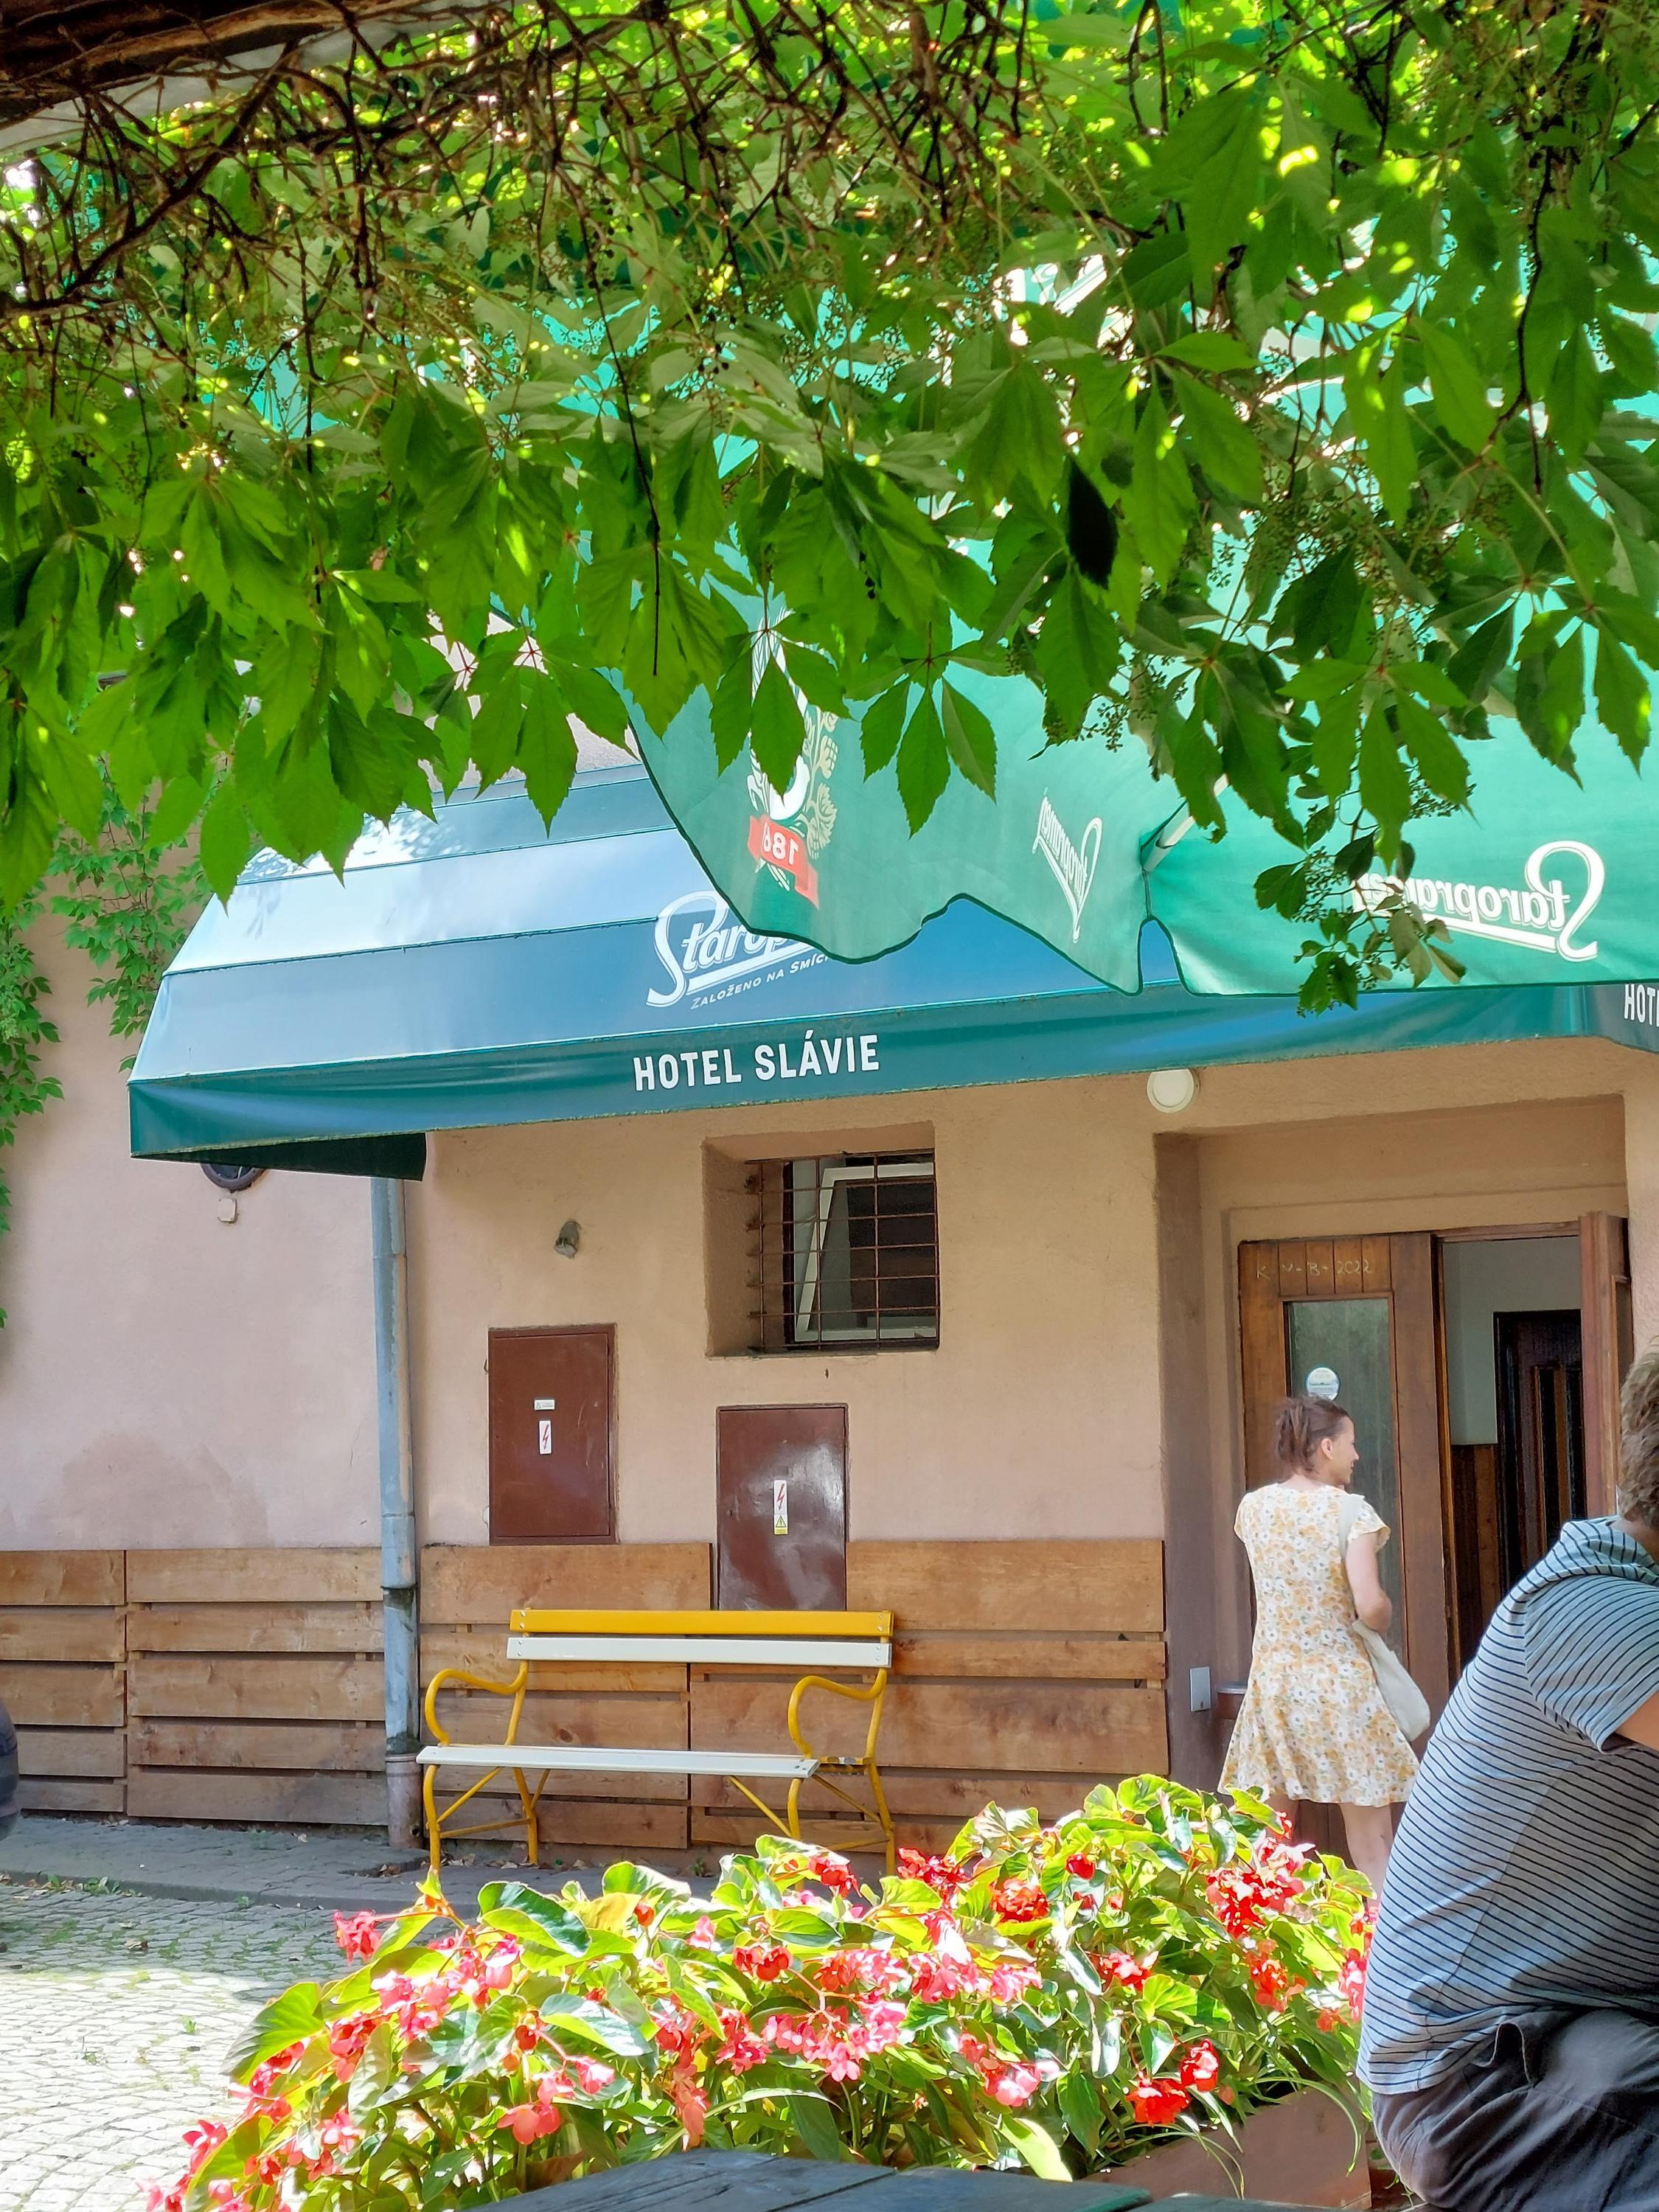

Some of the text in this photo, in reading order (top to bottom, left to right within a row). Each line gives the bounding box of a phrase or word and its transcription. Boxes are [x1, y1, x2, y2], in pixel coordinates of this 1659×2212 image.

[690, 953, 830, 1010] ZALOŽENO NA SMÍC
[1624, 984, 1659, 1027] HOT
[633, 1029, 880, 1091] HOTEL SLÁVIE
